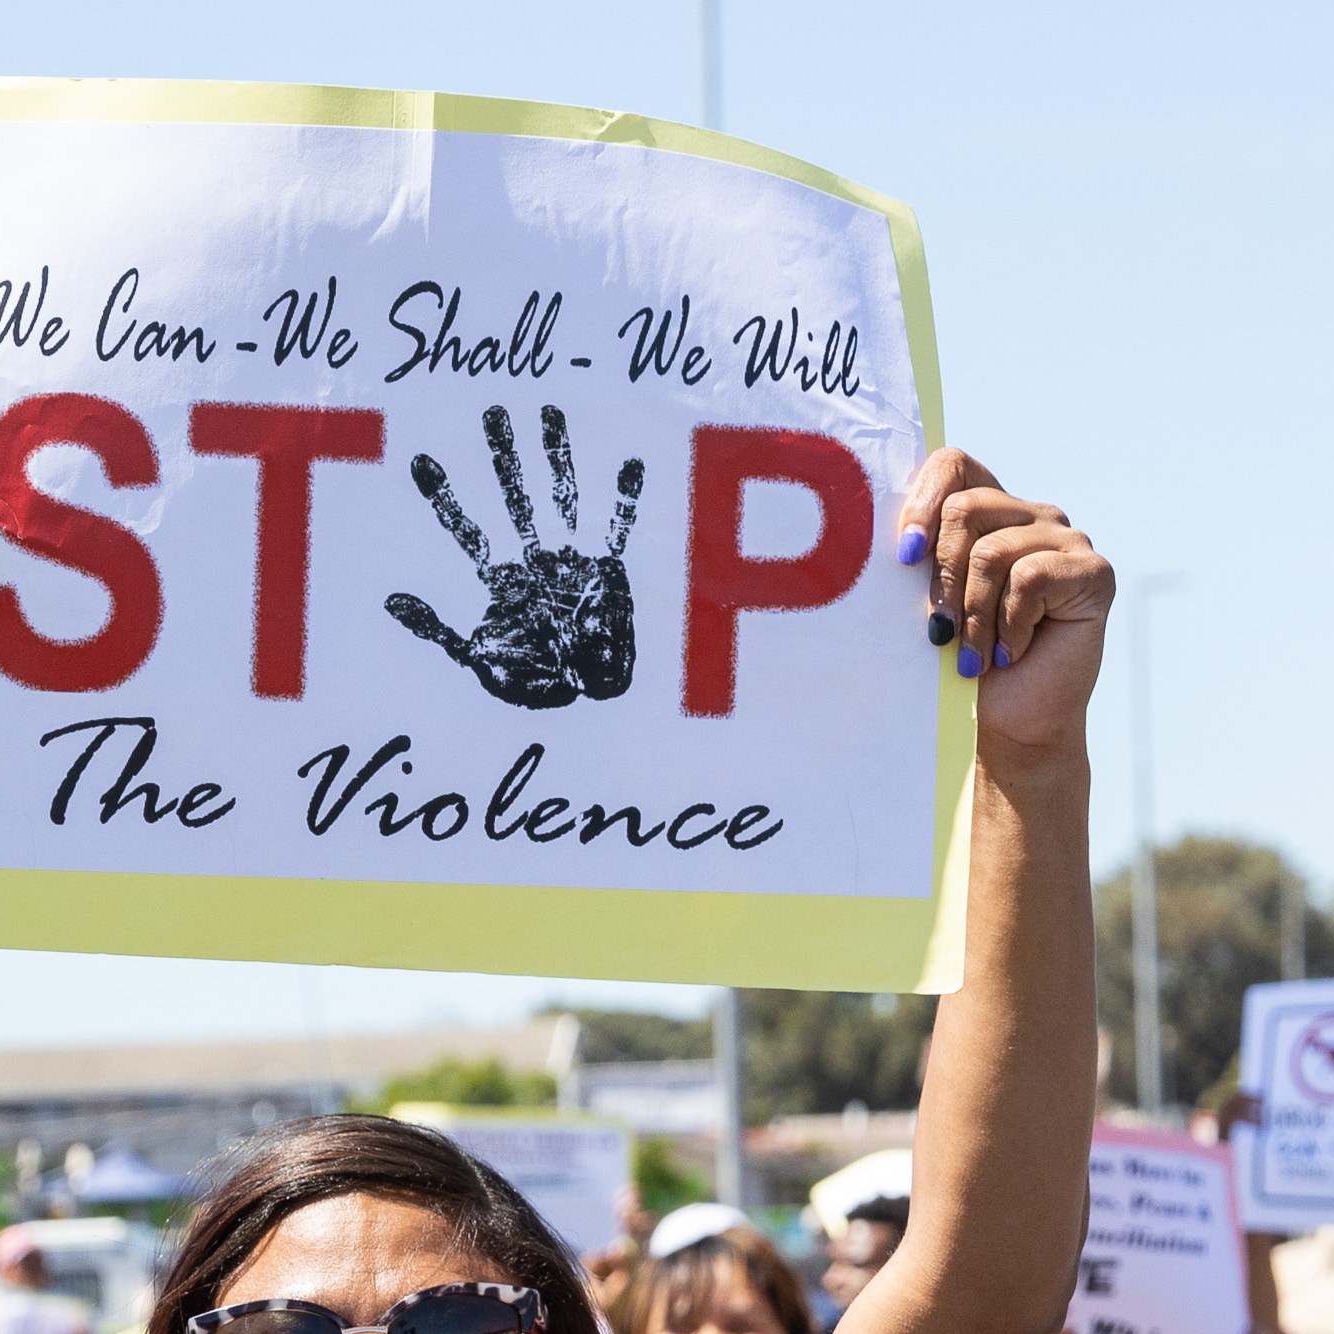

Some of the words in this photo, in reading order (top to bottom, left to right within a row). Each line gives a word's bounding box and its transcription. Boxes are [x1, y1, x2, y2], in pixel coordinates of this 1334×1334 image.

[95, 266, 216, 364] Can
[384, 279, 564, 384] Shall
[616, 293, 712, 387] We
[732, 306, 863, 399] Will
[38, 715, 237, 830] The
[296, 733, 785, 853] Violence
[1080, 1256, 1119, 1294] E
